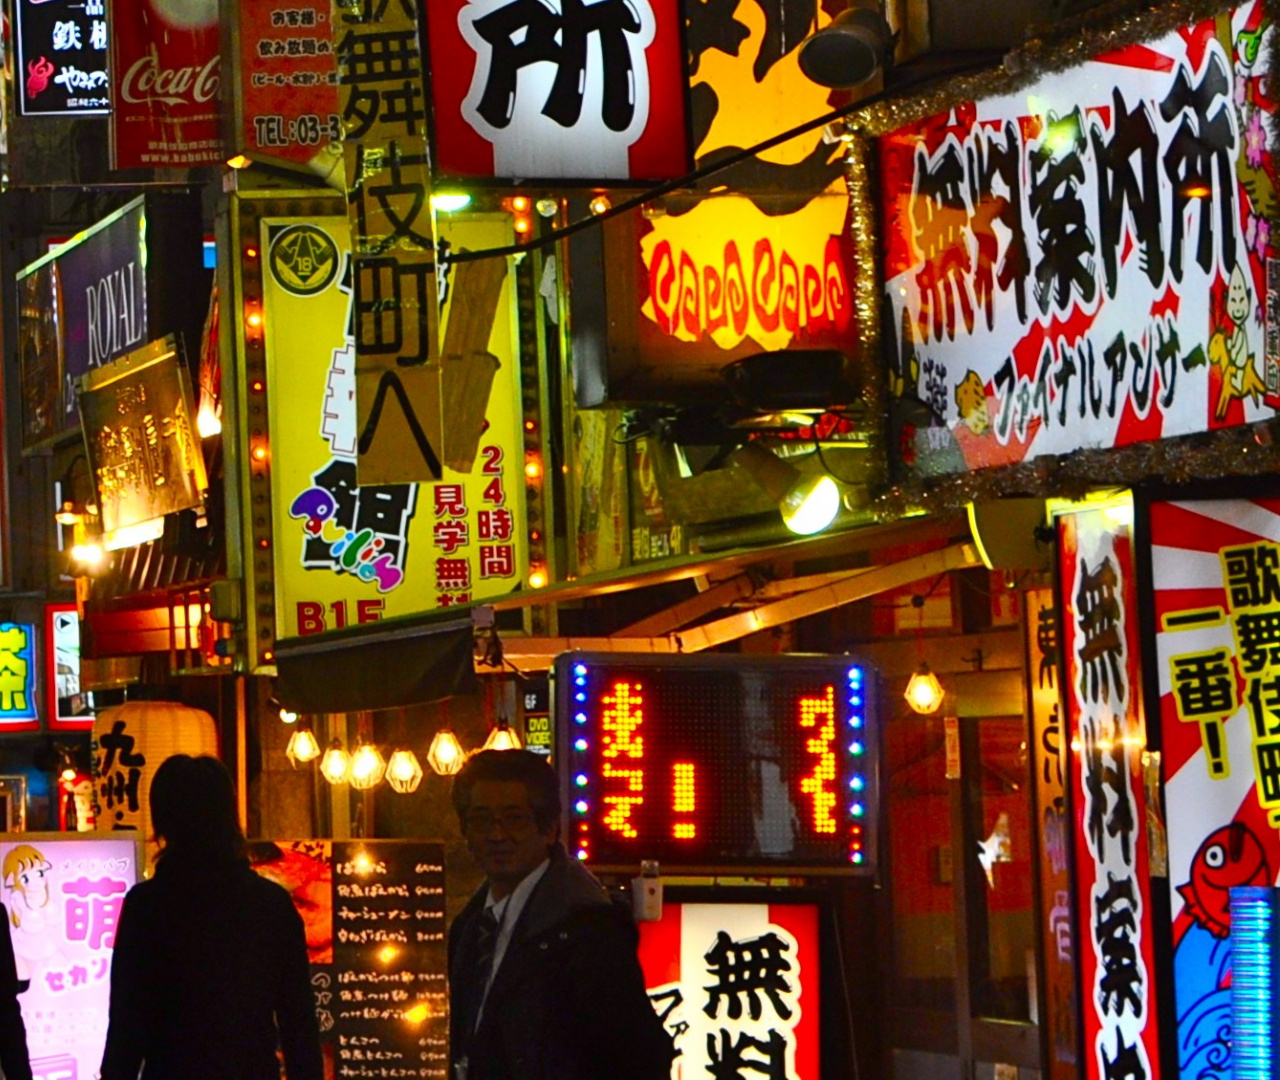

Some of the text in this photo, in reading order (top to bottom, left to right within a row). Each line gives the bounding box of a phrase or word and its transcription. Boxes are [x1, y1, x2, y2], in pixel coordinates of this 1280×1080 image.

[912, 50, 1238, 345] 無料案内所
[992, 330, 1206, 442] ファイナルアンサー
[479, 445, 517, 579] 24時間
